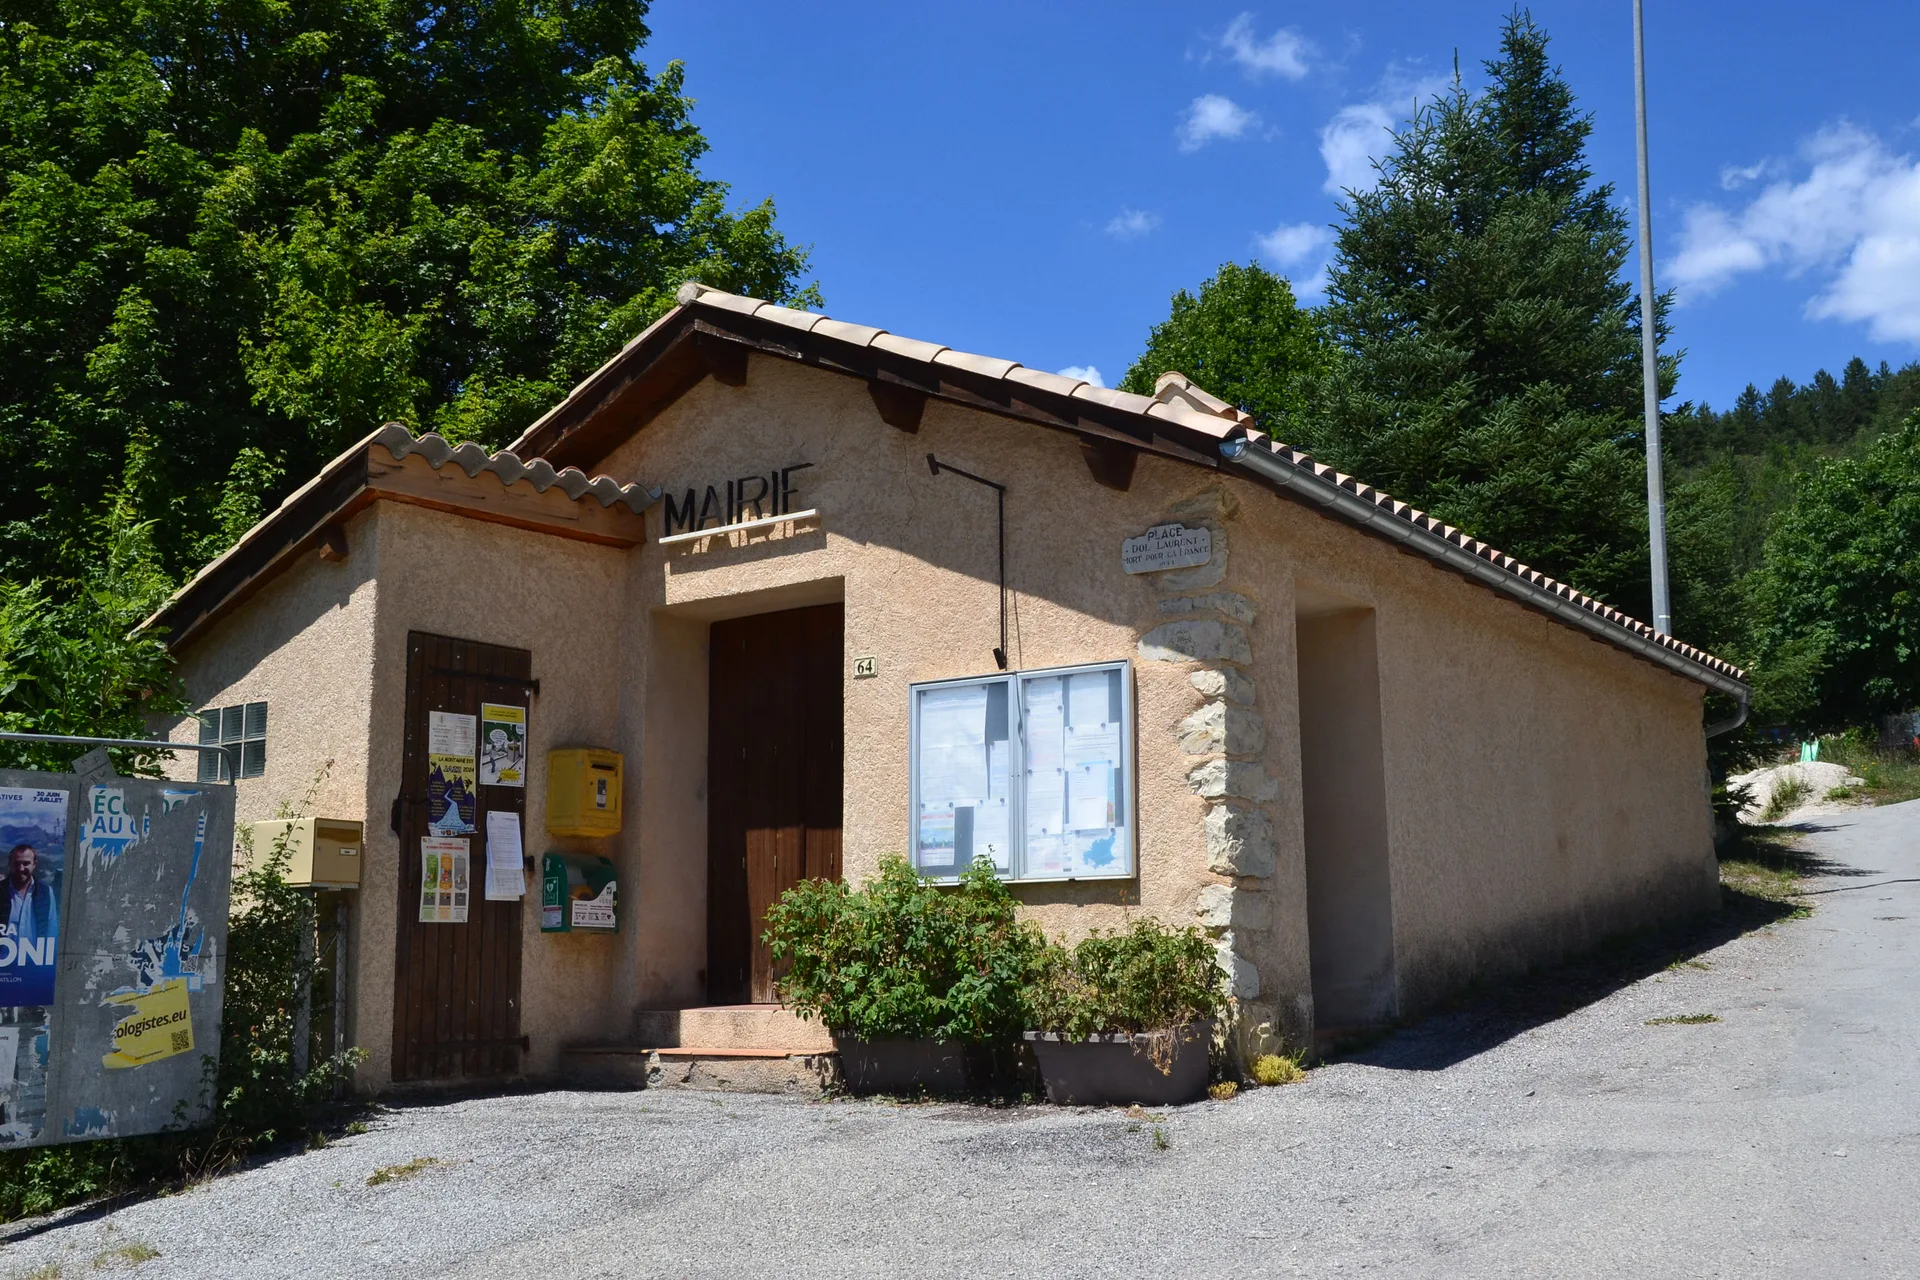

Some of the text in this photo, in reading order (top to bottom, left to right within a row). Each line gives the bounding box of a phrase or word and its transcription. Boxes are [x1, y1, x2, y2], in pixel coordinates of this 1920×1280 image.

[665, 462, 815, 536] MAIRIE
[1147, 527, 1182, 541] PLACE
[1131, 537, 1198, 554] DOL LAURENT
[1123, 555, 1143, 564] MORT
[1145, 552, 1164, 561] POUR
[1179, 545, 1209, 557] FRANCE
[857, 659, 873, 675] 64
[0, 793, 23, 801] TIVES
[92, 815, 123, 834] AU
